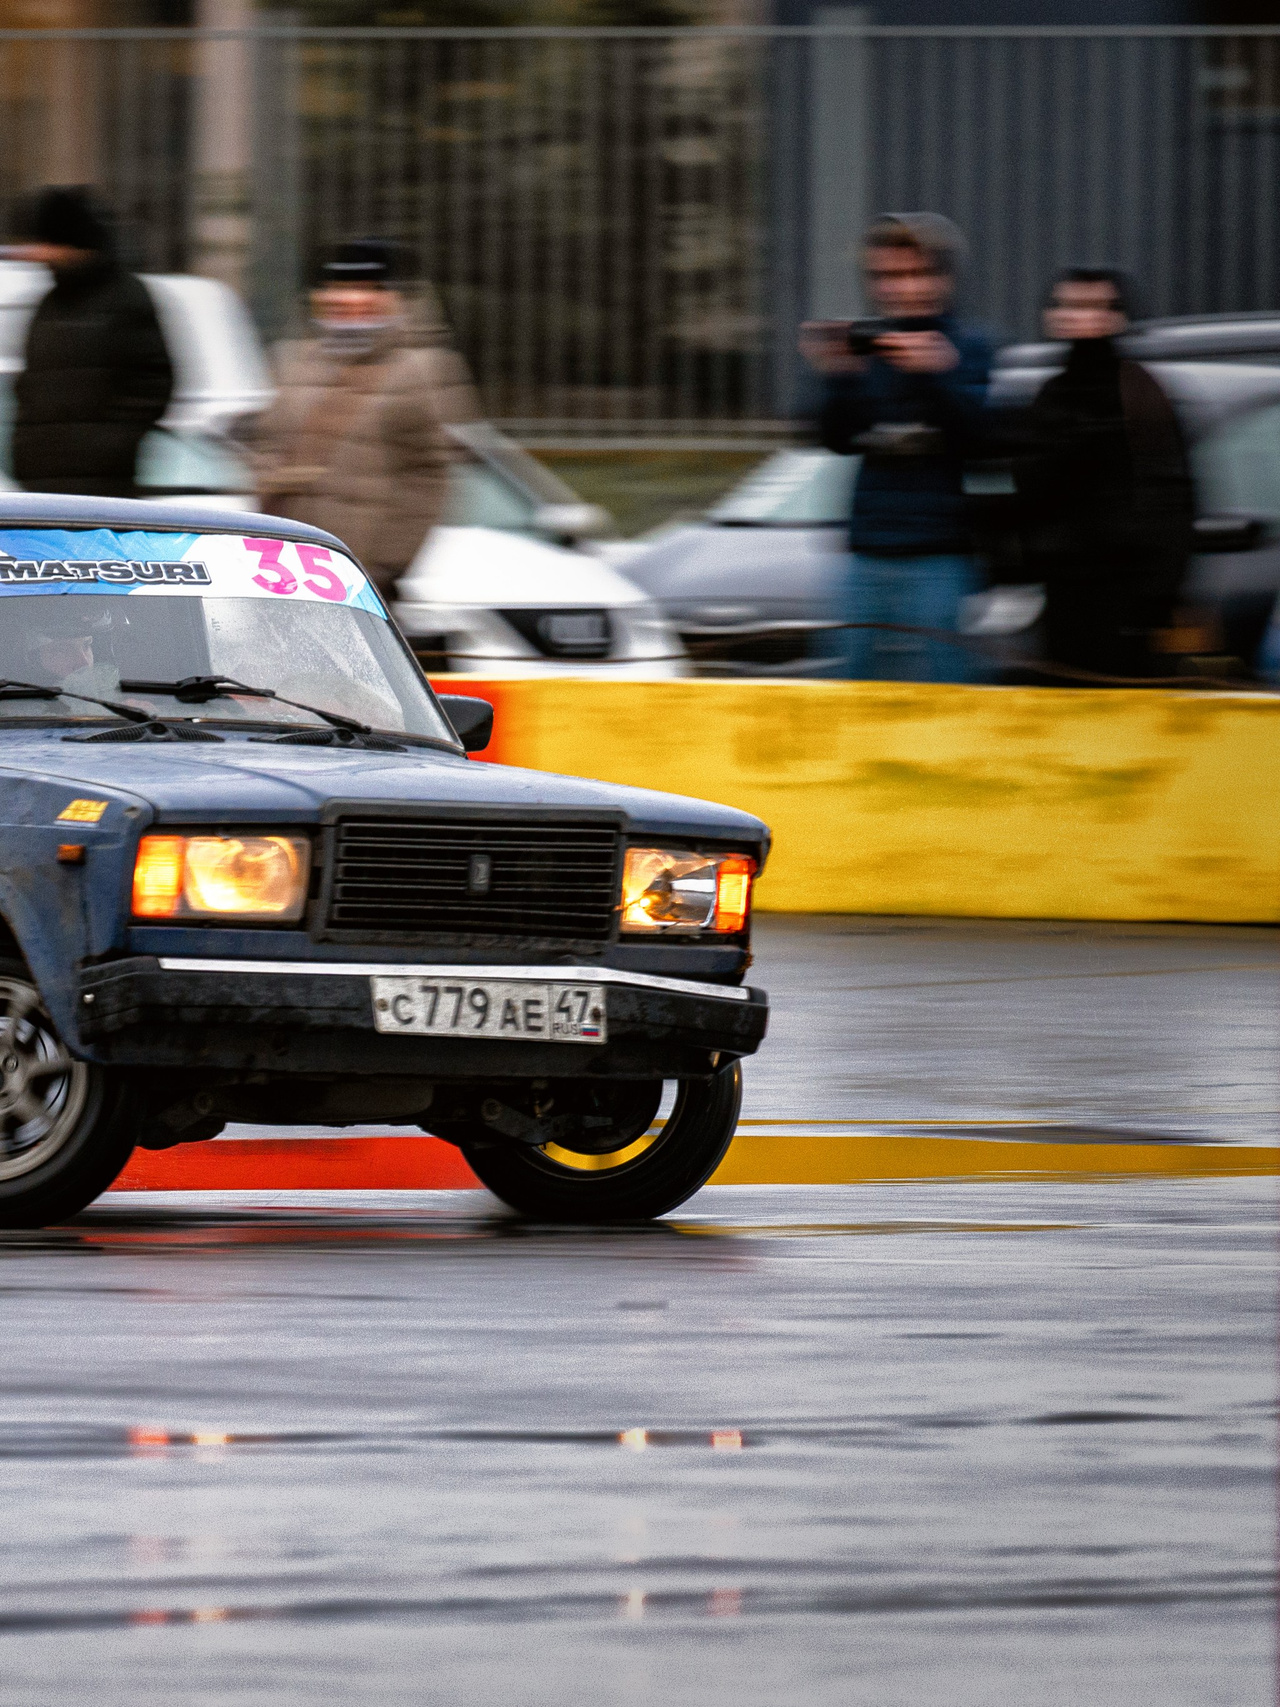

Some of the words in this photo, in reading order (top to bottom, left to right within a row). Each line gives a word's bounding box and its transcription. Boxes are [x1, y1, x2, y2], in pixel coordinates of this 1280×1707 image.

[242, 538, 347, 602] 35
[556, 990, 590, 1023] 47
[553, 1022, 579, 1036] RUS
